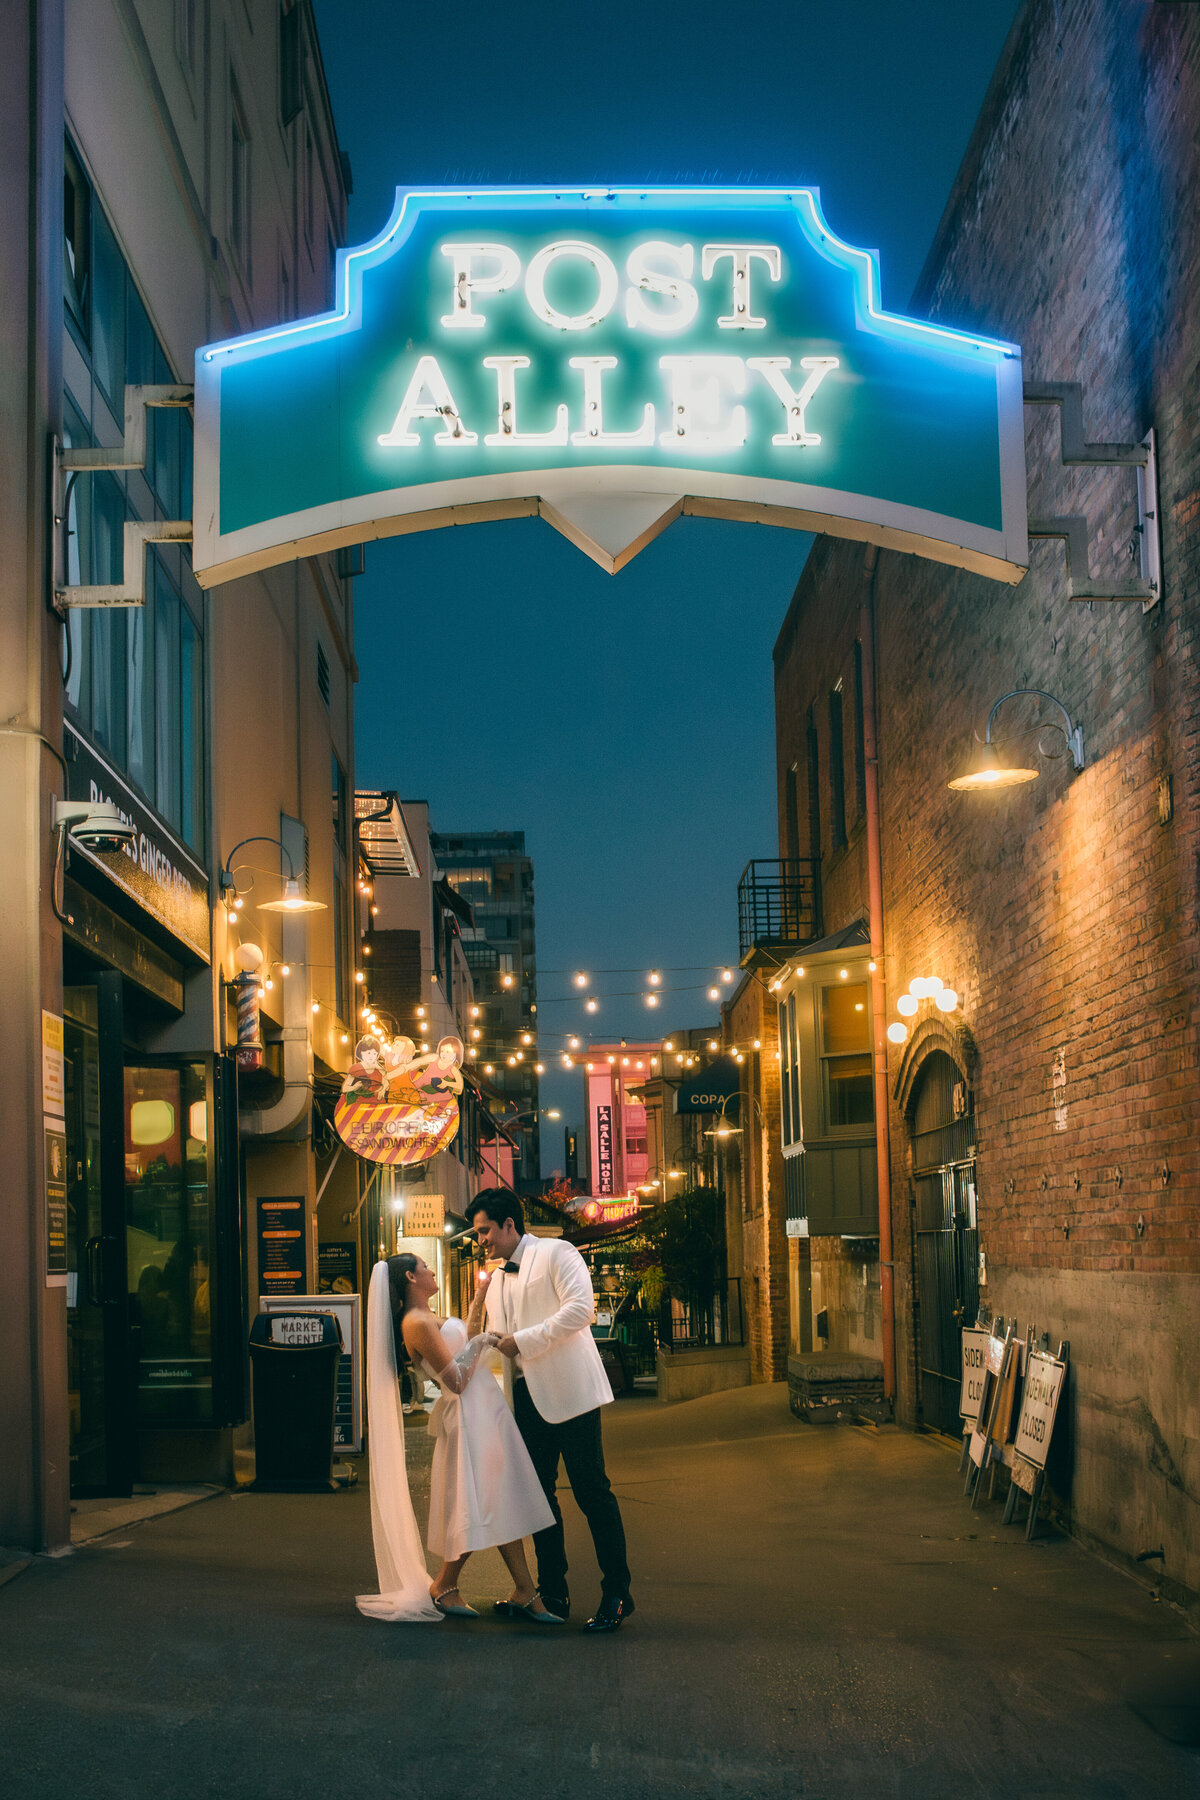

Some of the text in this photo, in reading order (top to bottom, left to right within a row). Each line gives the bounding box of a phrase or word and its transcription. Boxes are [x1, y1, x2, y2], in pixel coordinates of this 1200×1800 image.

[441, 240, 783, 331] POST
[377, 354, 841, 447] ALLEY
[139, 832, 173, 891] GINGER
[690, 1094, 725, 1105] COPA
[351, 1120, 444, 1135] EUROPEAN
[350, 1136, 445, 1150] SANDWICHES
[599, 1106, 611, 1192] LA SALLE HOTE
[281, 1321, 323, 1333] MARKET
[288, 1334, 323, 1345] CENTE
[1022, 1412, 1046, 1443] CLOSED
